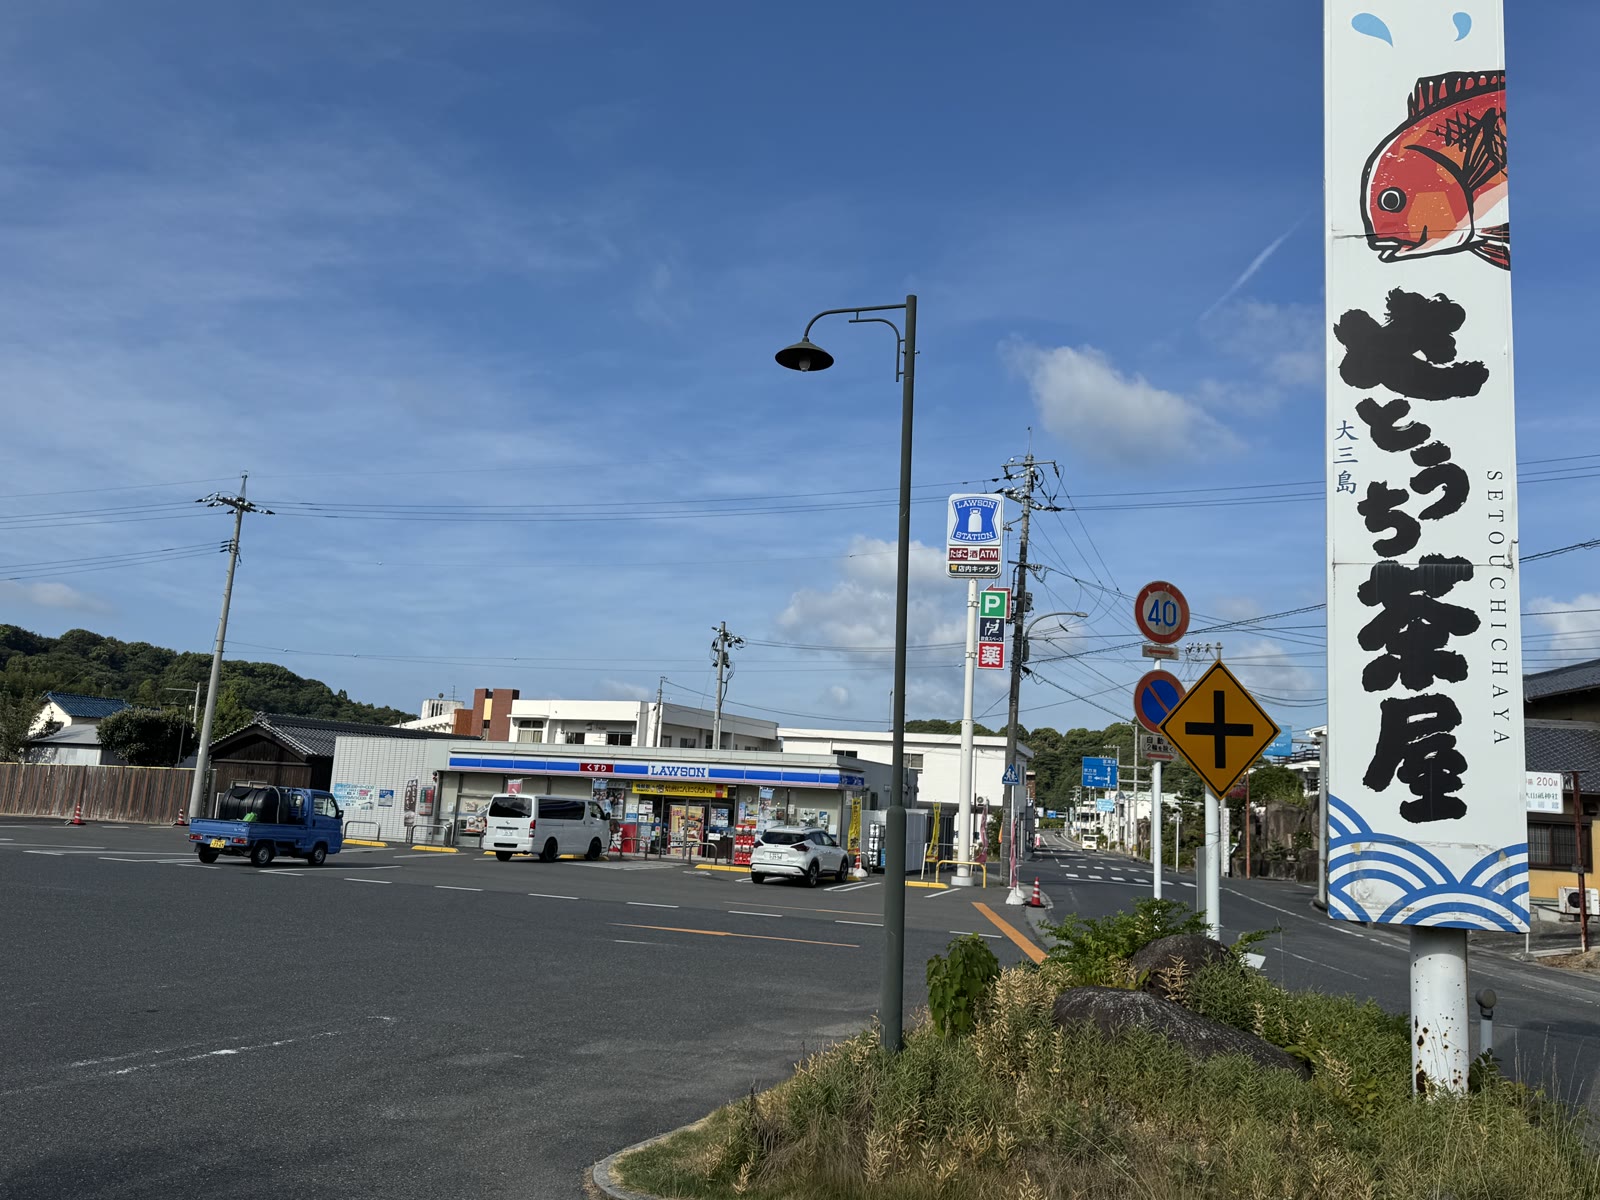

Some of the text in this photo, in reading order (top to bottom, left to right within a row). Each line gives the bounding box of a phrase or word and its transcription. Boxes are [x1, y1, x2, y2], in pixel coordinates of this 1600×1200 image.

[1335, 420, 1358, 495] 大三島
[957, 497, 996, 510] LAWSON
[956, 531, 994, 542] STATION
[949, 549, 968, 558] たばこ
[980, 550, 998, 559] ATM
[1333, 287, 1489, 824] せとうち茶屋
[958, 564, 998, 573] 店内キッチン
[984, 595, 1001, 614] P
[1486, 470, 1510, 745] SETOUCHICHAYA
[1148, 599, 1177, 627] 40
[981, 646, 1001, 665] 薬
[587, 764, 607, 772] くすり
[651, 766, 706, 778] LAWSON
